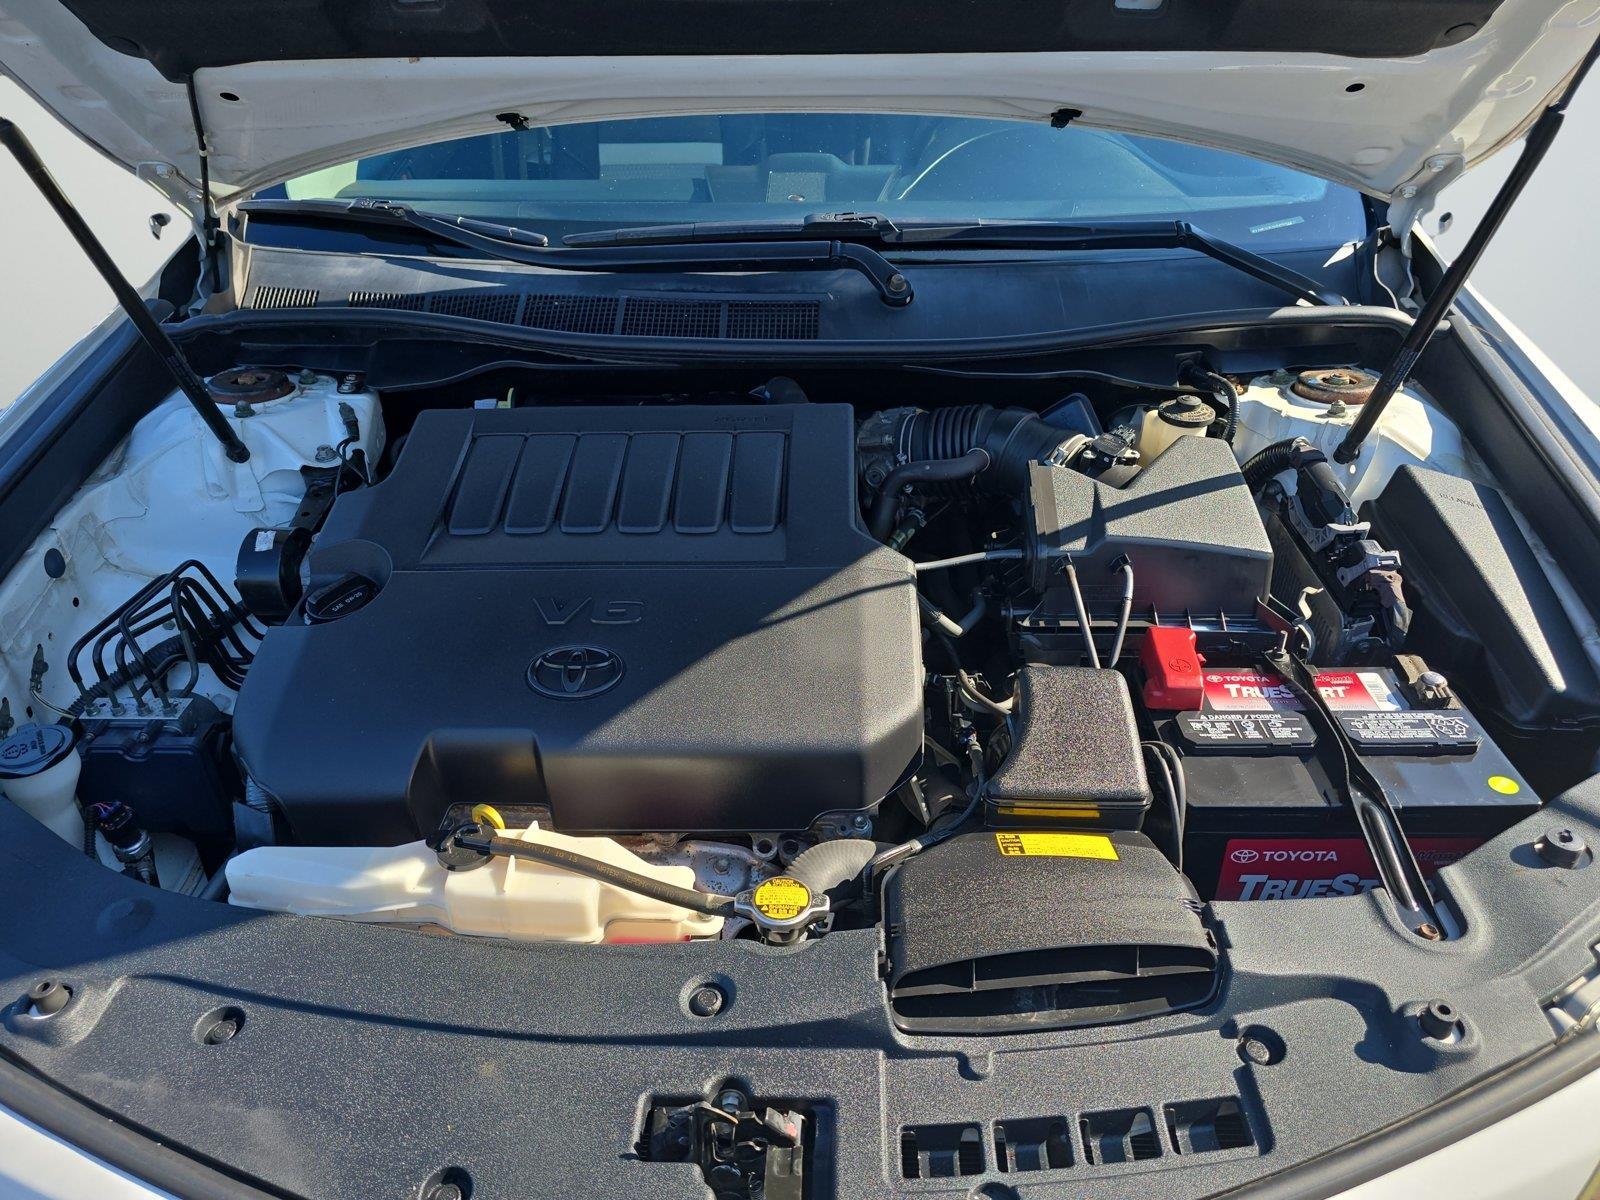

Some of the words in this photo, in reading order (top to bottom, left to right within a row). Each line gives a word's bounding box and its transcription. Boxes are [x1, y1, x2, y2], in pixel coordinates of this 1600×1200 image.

[532, 596, 645, 625] V6
[1223, 675, 1271, 683] TOYOTA
[1262, 850, 1338, 862] TOYOTA
